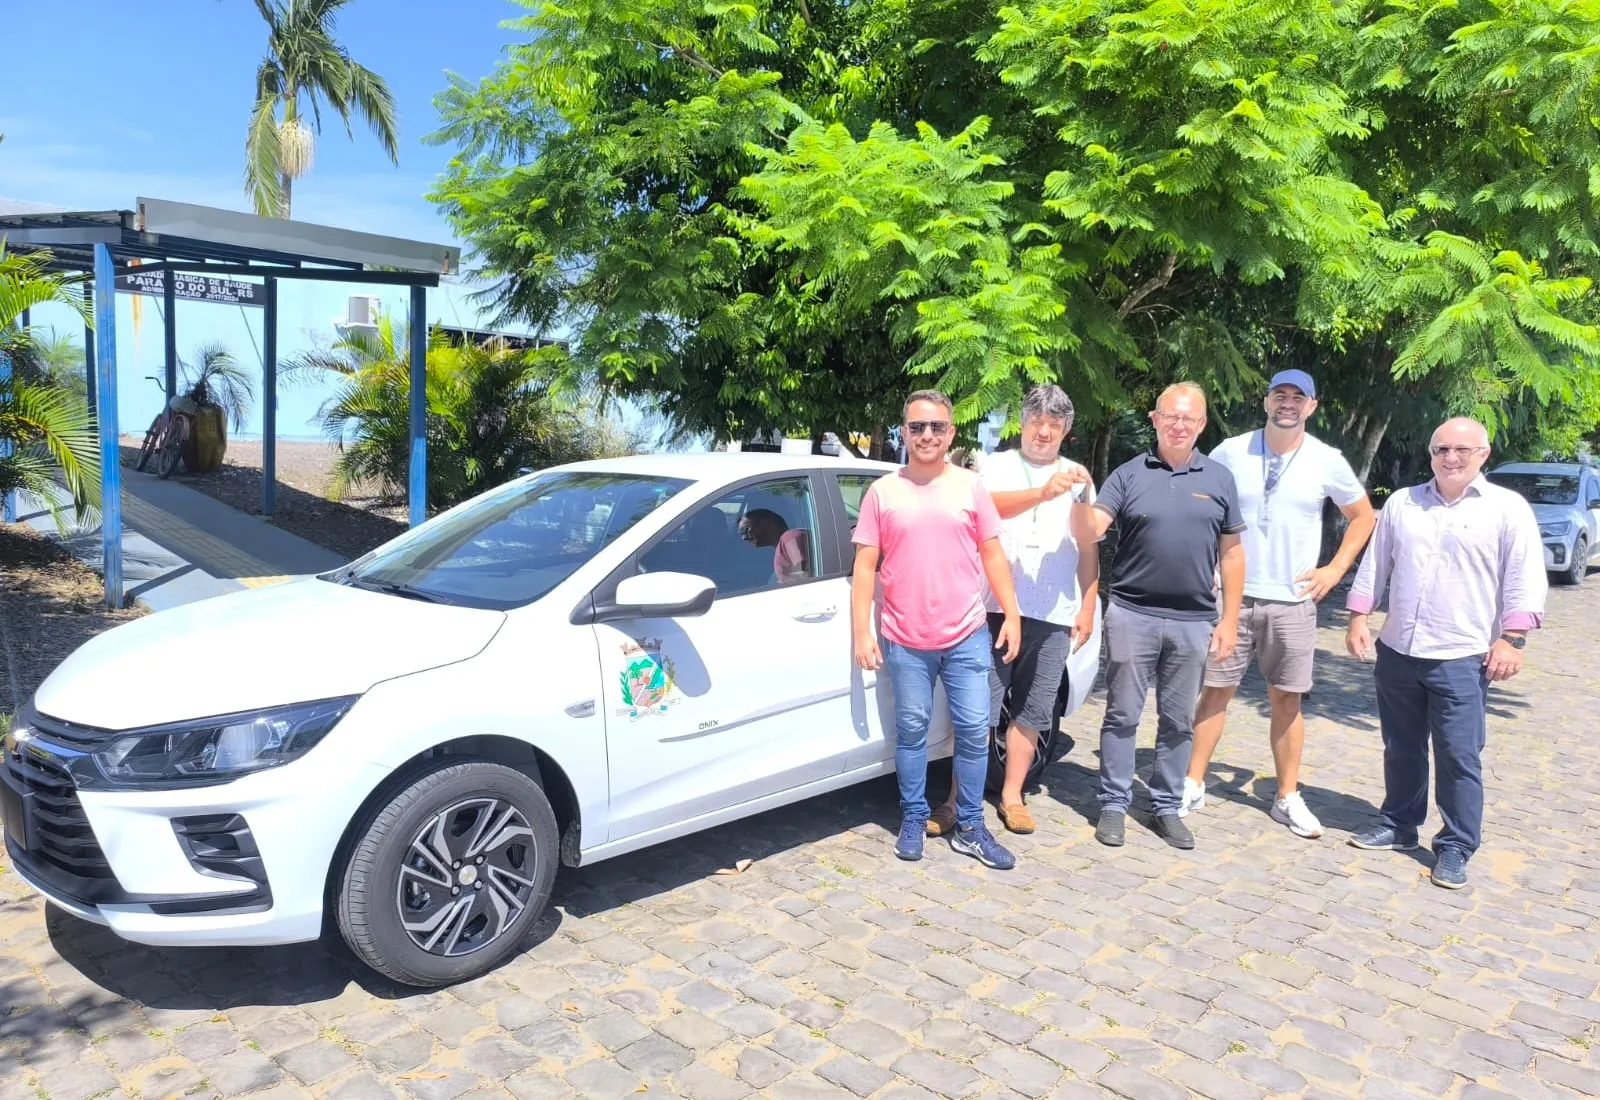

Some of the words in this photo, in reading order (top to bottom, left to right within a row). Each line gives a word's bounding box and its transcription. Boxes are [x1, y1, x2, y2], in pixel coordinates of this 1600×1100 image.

[208, 278, 220, 287] DE
[188, 283, 206, 292] DO
[210, 286, 254, 298] SUL-RS
[699, 720, 719, 730] ONIX
